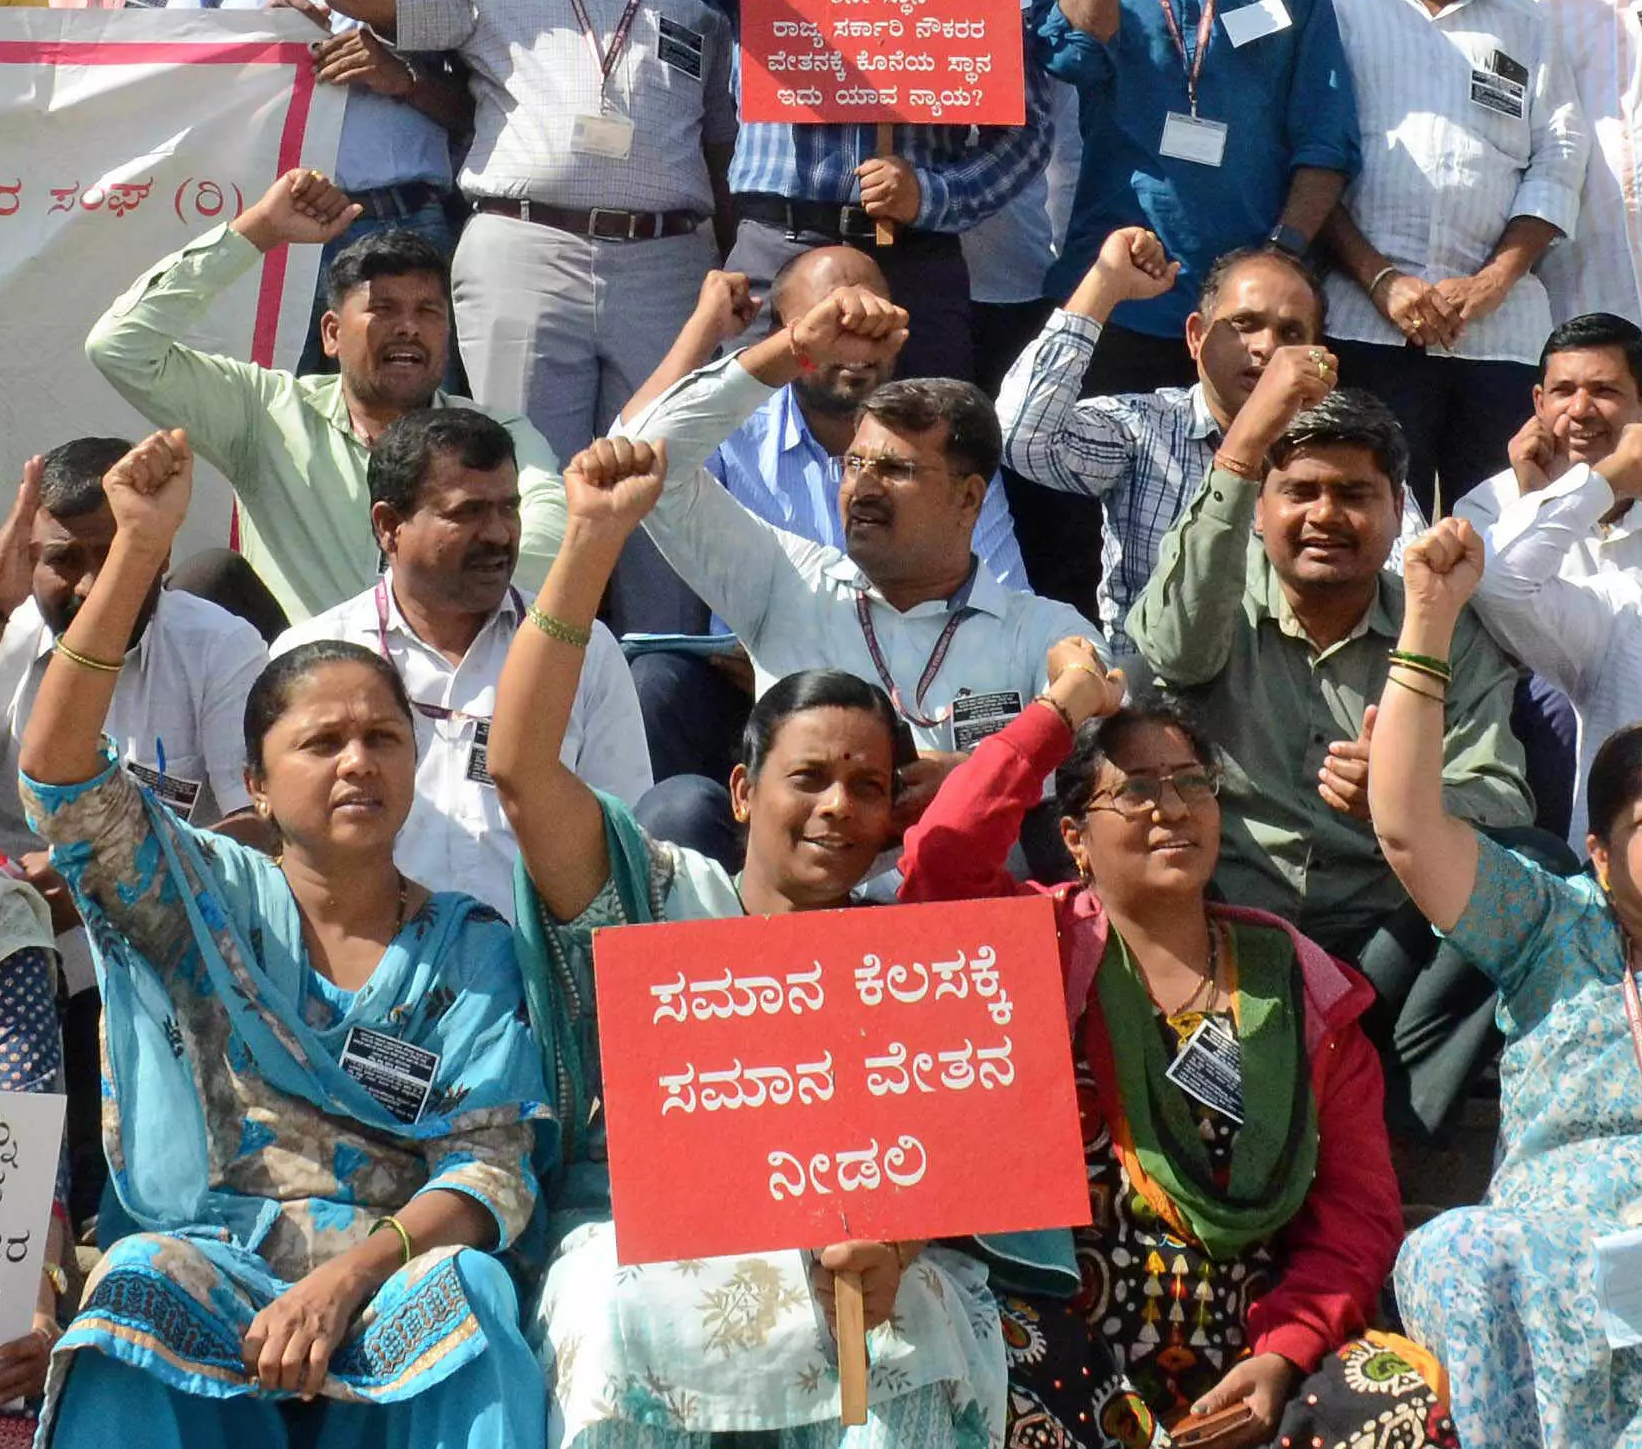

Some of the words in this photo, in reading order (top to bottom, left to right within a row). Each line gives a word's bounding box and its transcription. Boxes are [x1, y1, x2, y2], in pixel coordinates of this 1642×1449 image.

[772, 19, 824, 49] ರಾಜ್ಯ
[833, 17, 904, 39] ಸರ್ಕಾರಿ
[915, 16, 986, 40] ನೌಕರರ
[767, 51, 847, 83] ವೇತನಕ್ಕೆ
[856, 51, 936, 73] ಕೊನೆಯ
[947, 53, 992, 85] ಸ್ಥಾನ
[776, 87, 823, 107] ಇದು
[835, 86, 899, 106] ಯಾವ
[908, 87, 984, 118] ನ್ಯಾಯ?
[47, 176, 155, 218] ಸಂಘ
[650, 960, 825, 1025] ಸಮಾನ
[854, 944, 1014, 1025] ಕೆಲಸಕ್ಕೆ
[658, 1049, 836, 1116] ಸಮಾನ
[864, 1035, 1016, 1097] ವೇತನ
[768, 1133, 928, 1201] ನೀಡಲಿ
